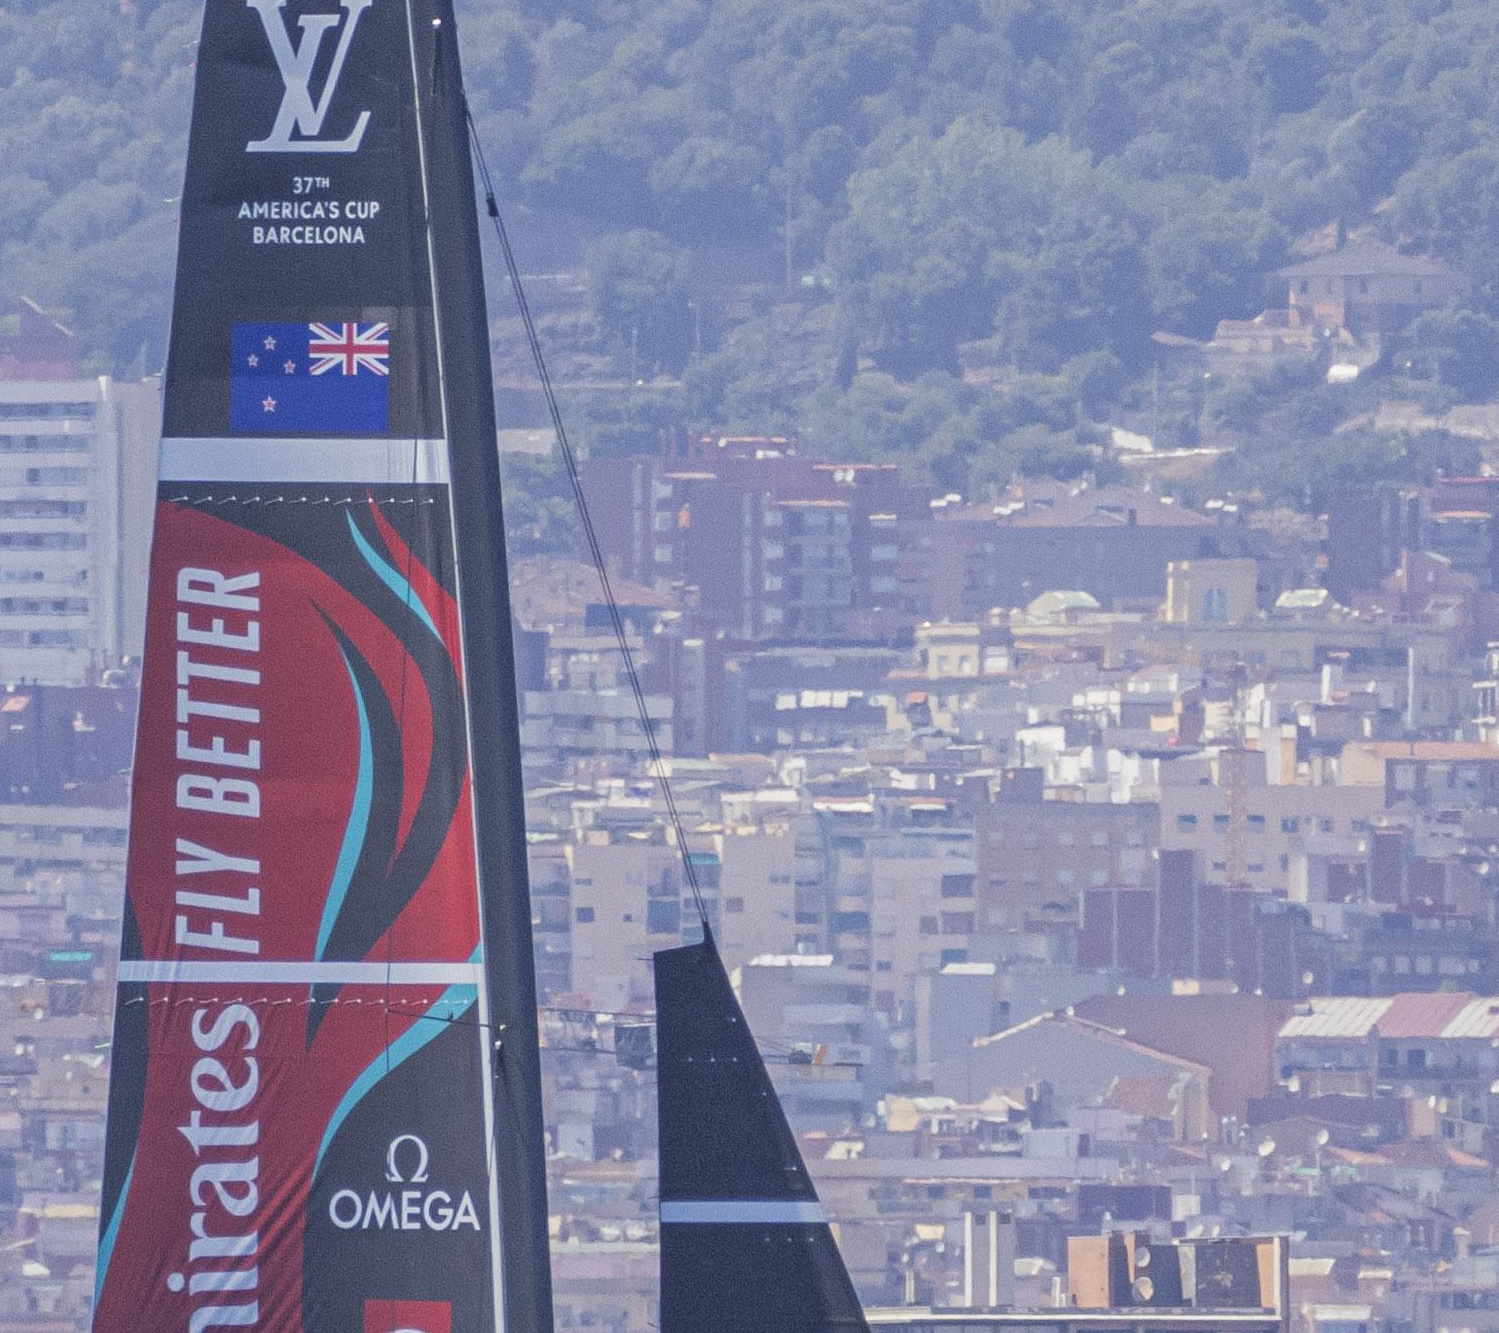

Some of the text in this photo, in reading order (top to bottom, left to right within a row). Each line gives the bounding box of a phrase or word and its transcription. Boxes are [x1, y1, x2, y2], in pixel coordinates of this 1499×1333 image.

[293, 176, 330, 195] 37TH
[238, 200, 380, 220] AMERICA'S CUP
[253, 225, 365, 245] BARCELONA
[175, 567, 261, 954] FLY BETTER
[329, 1189, 481, 1231] OMEGA
